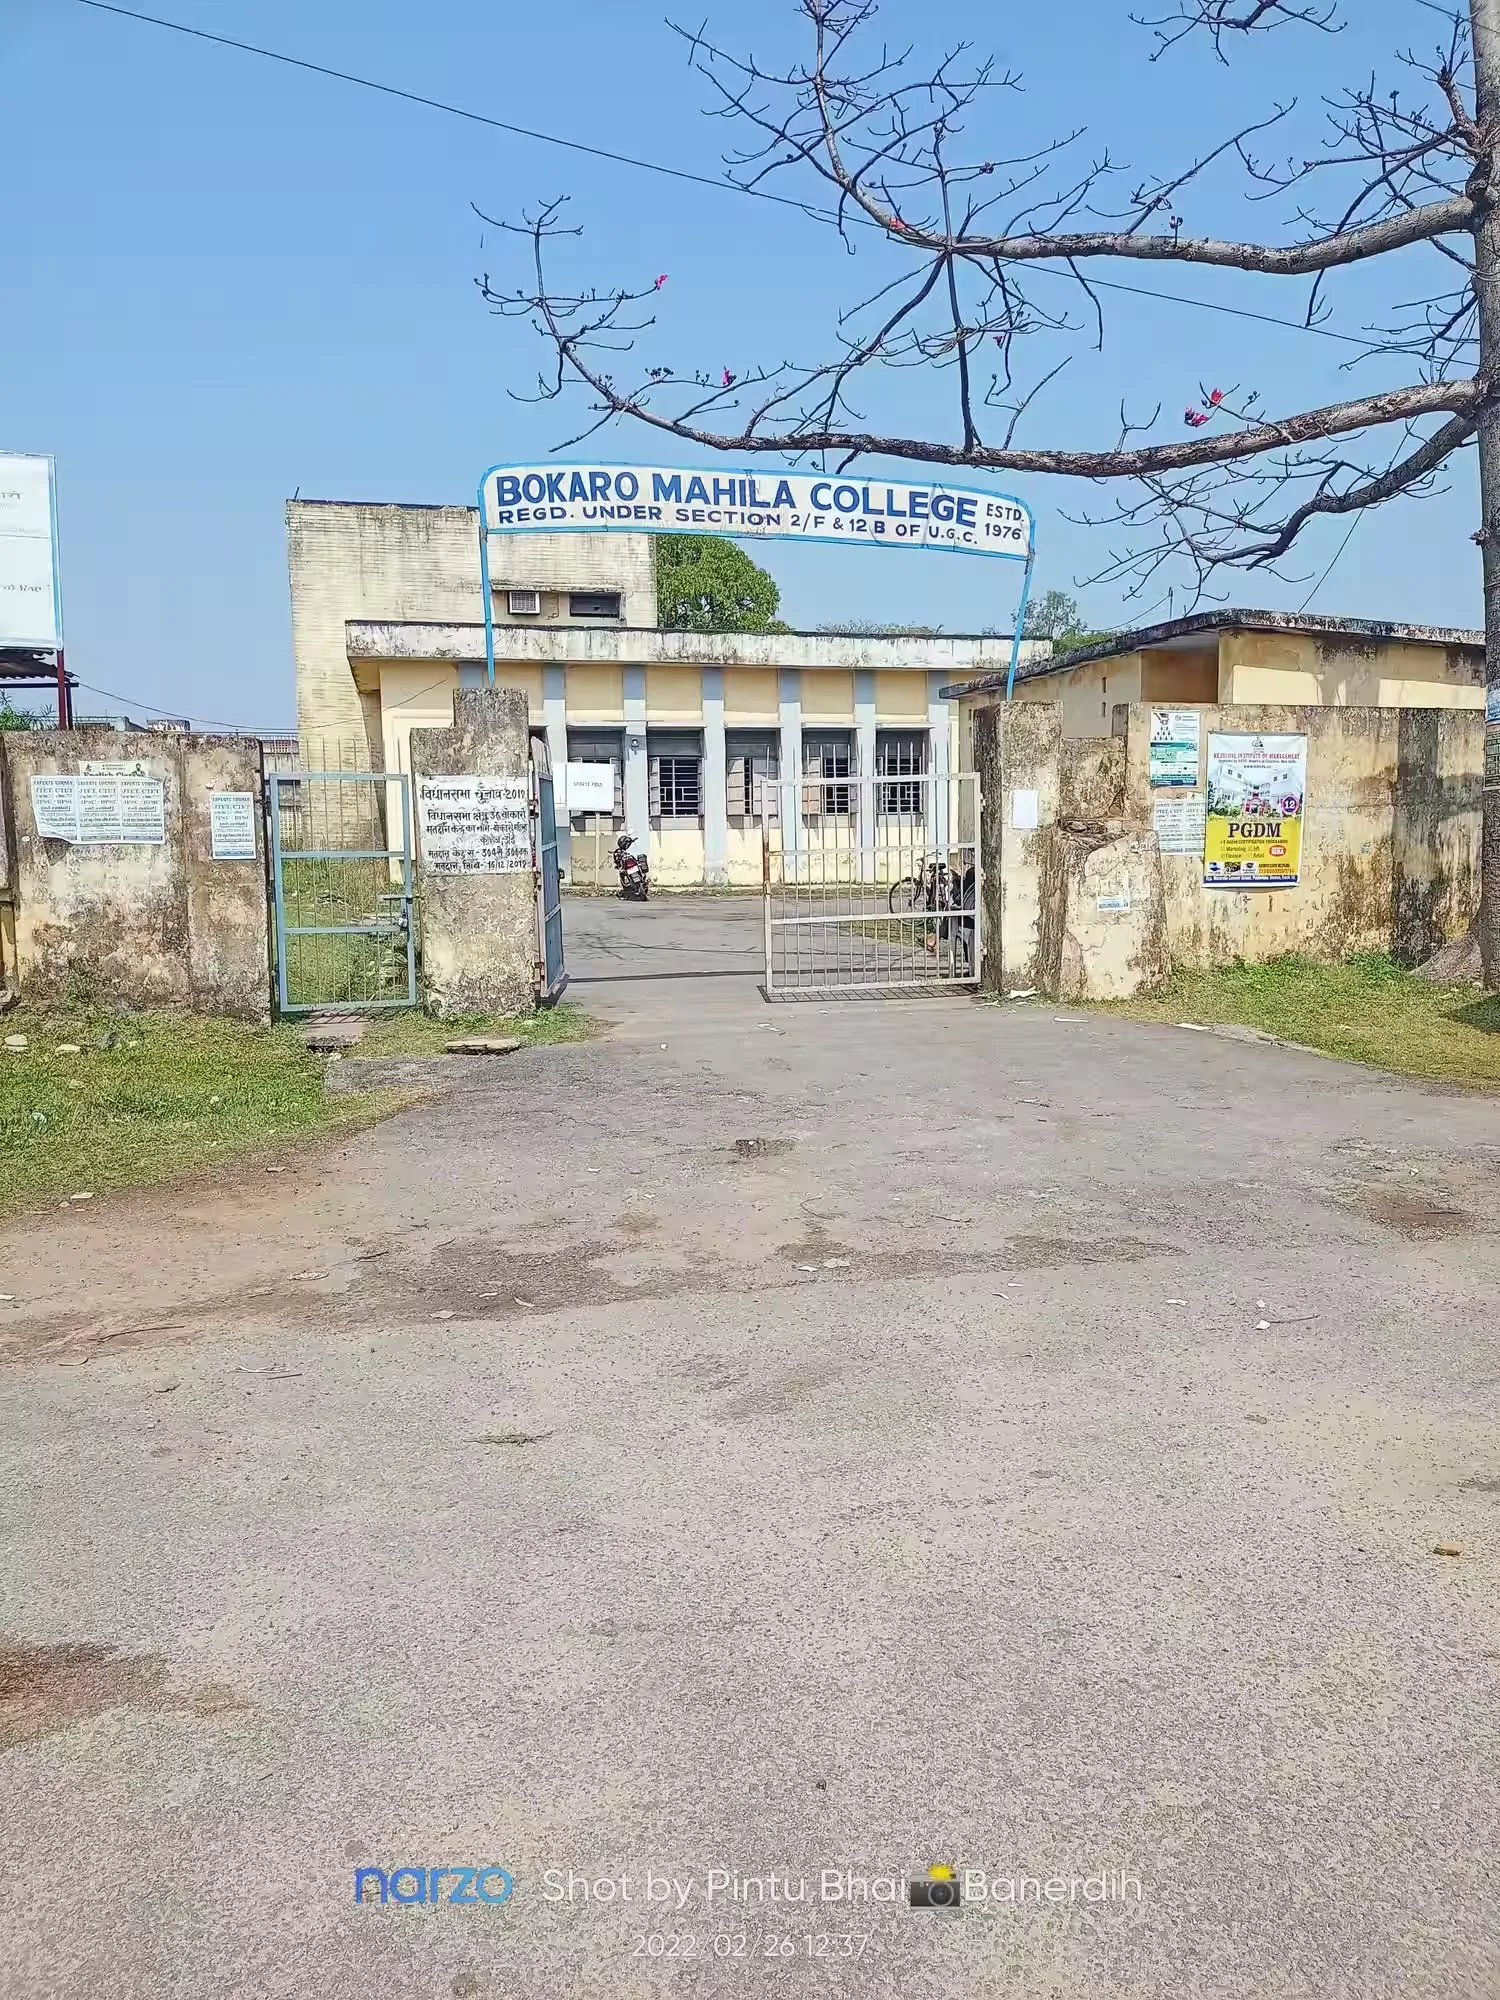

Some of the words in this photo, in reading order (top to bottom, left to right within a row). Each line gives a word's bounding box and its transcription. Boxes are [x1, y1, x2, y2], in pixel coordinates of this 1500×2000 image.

[496, 471, 639, 507] BOKARO
[652, 473, 796, 509] MAHILA
[810, 482, 978, 528] COLLEGE
[499, 505, 575, 524] REGD.
[582, 506, 663, 521] UNDER
[675, 508, 781, 526] SECTION
[791, 513, 825, 532] 2/F
[833, 516, 844, 531] &
[895, 524, 921, 537] OF
[928, 526, 978, 544] U.G.C.
[984, 522, 1022, 540] 1976
[420, 785, 471, 803] विधानसभा
[1284, 800, 1295, 808] 12
[428, 809, 471, 823] विधानसभा
[1228, 823, 1281, 838] PGDM
